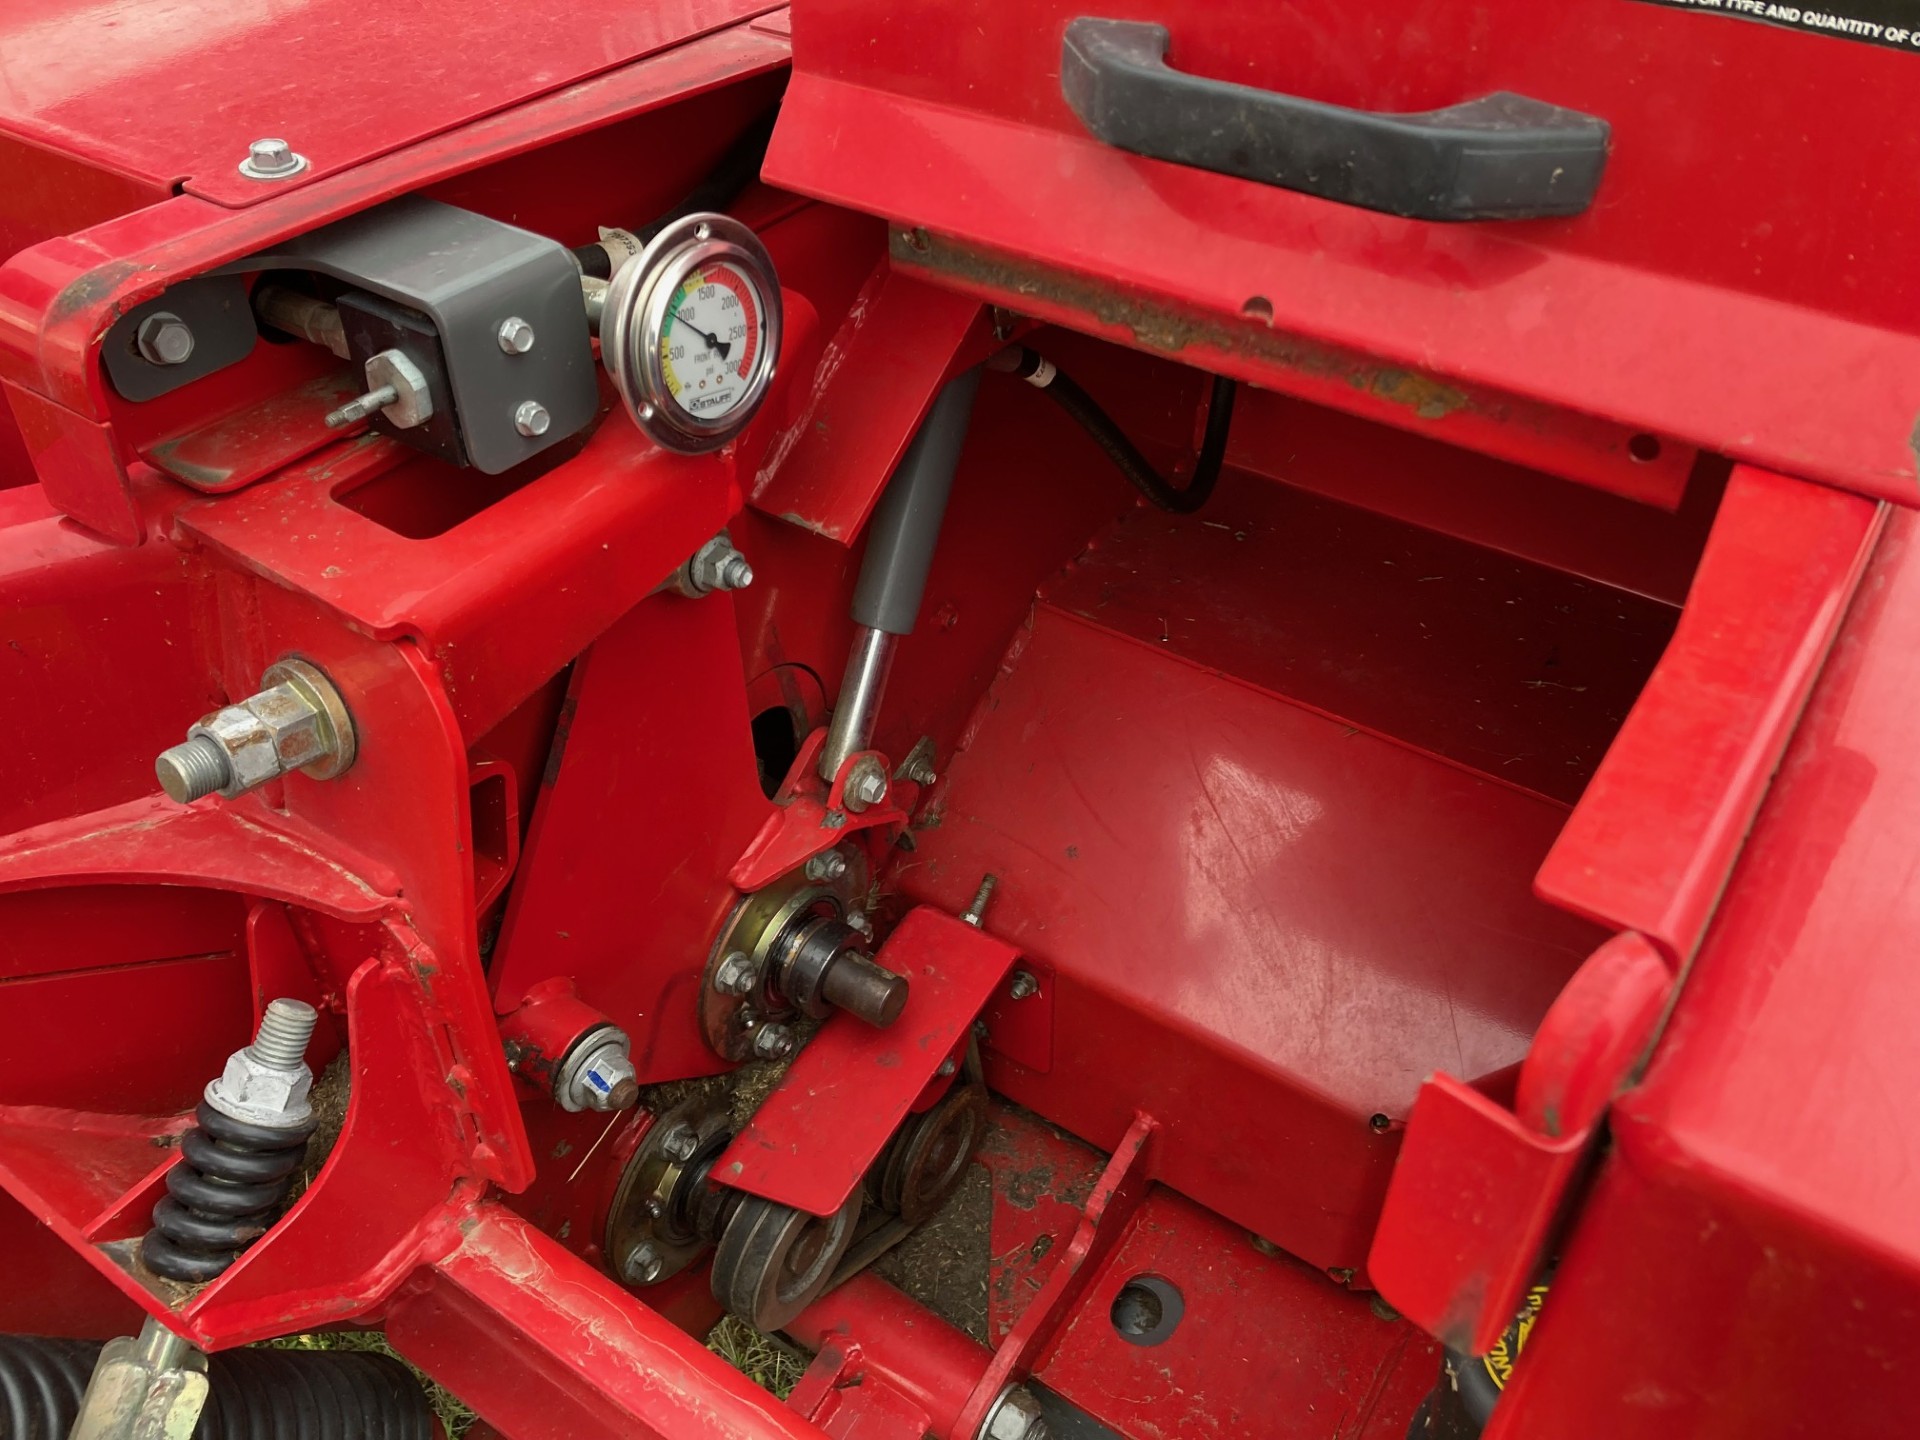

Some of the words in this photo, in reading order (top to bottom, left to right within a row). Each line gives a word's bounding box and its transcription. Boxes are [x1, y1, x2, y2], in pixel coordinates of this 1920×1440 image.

[1726, 0, 1766, 15] TYPE
[1765, 4, 1801, 22] AND
[1802, 10, 1884, 38] QUANTITY
[1884, 26, 1911, 43] OF
[697, 285, 715, 301] 1500
[721, 294, 739, 311] 2000
[677, 306, 695, 321] 1000
[728, 324, 747, 341] 2500
[669, 345, 685, 361] 500
[724, 358, 742, 375] 3000
[700, 393, 732, 409] STAUFF
